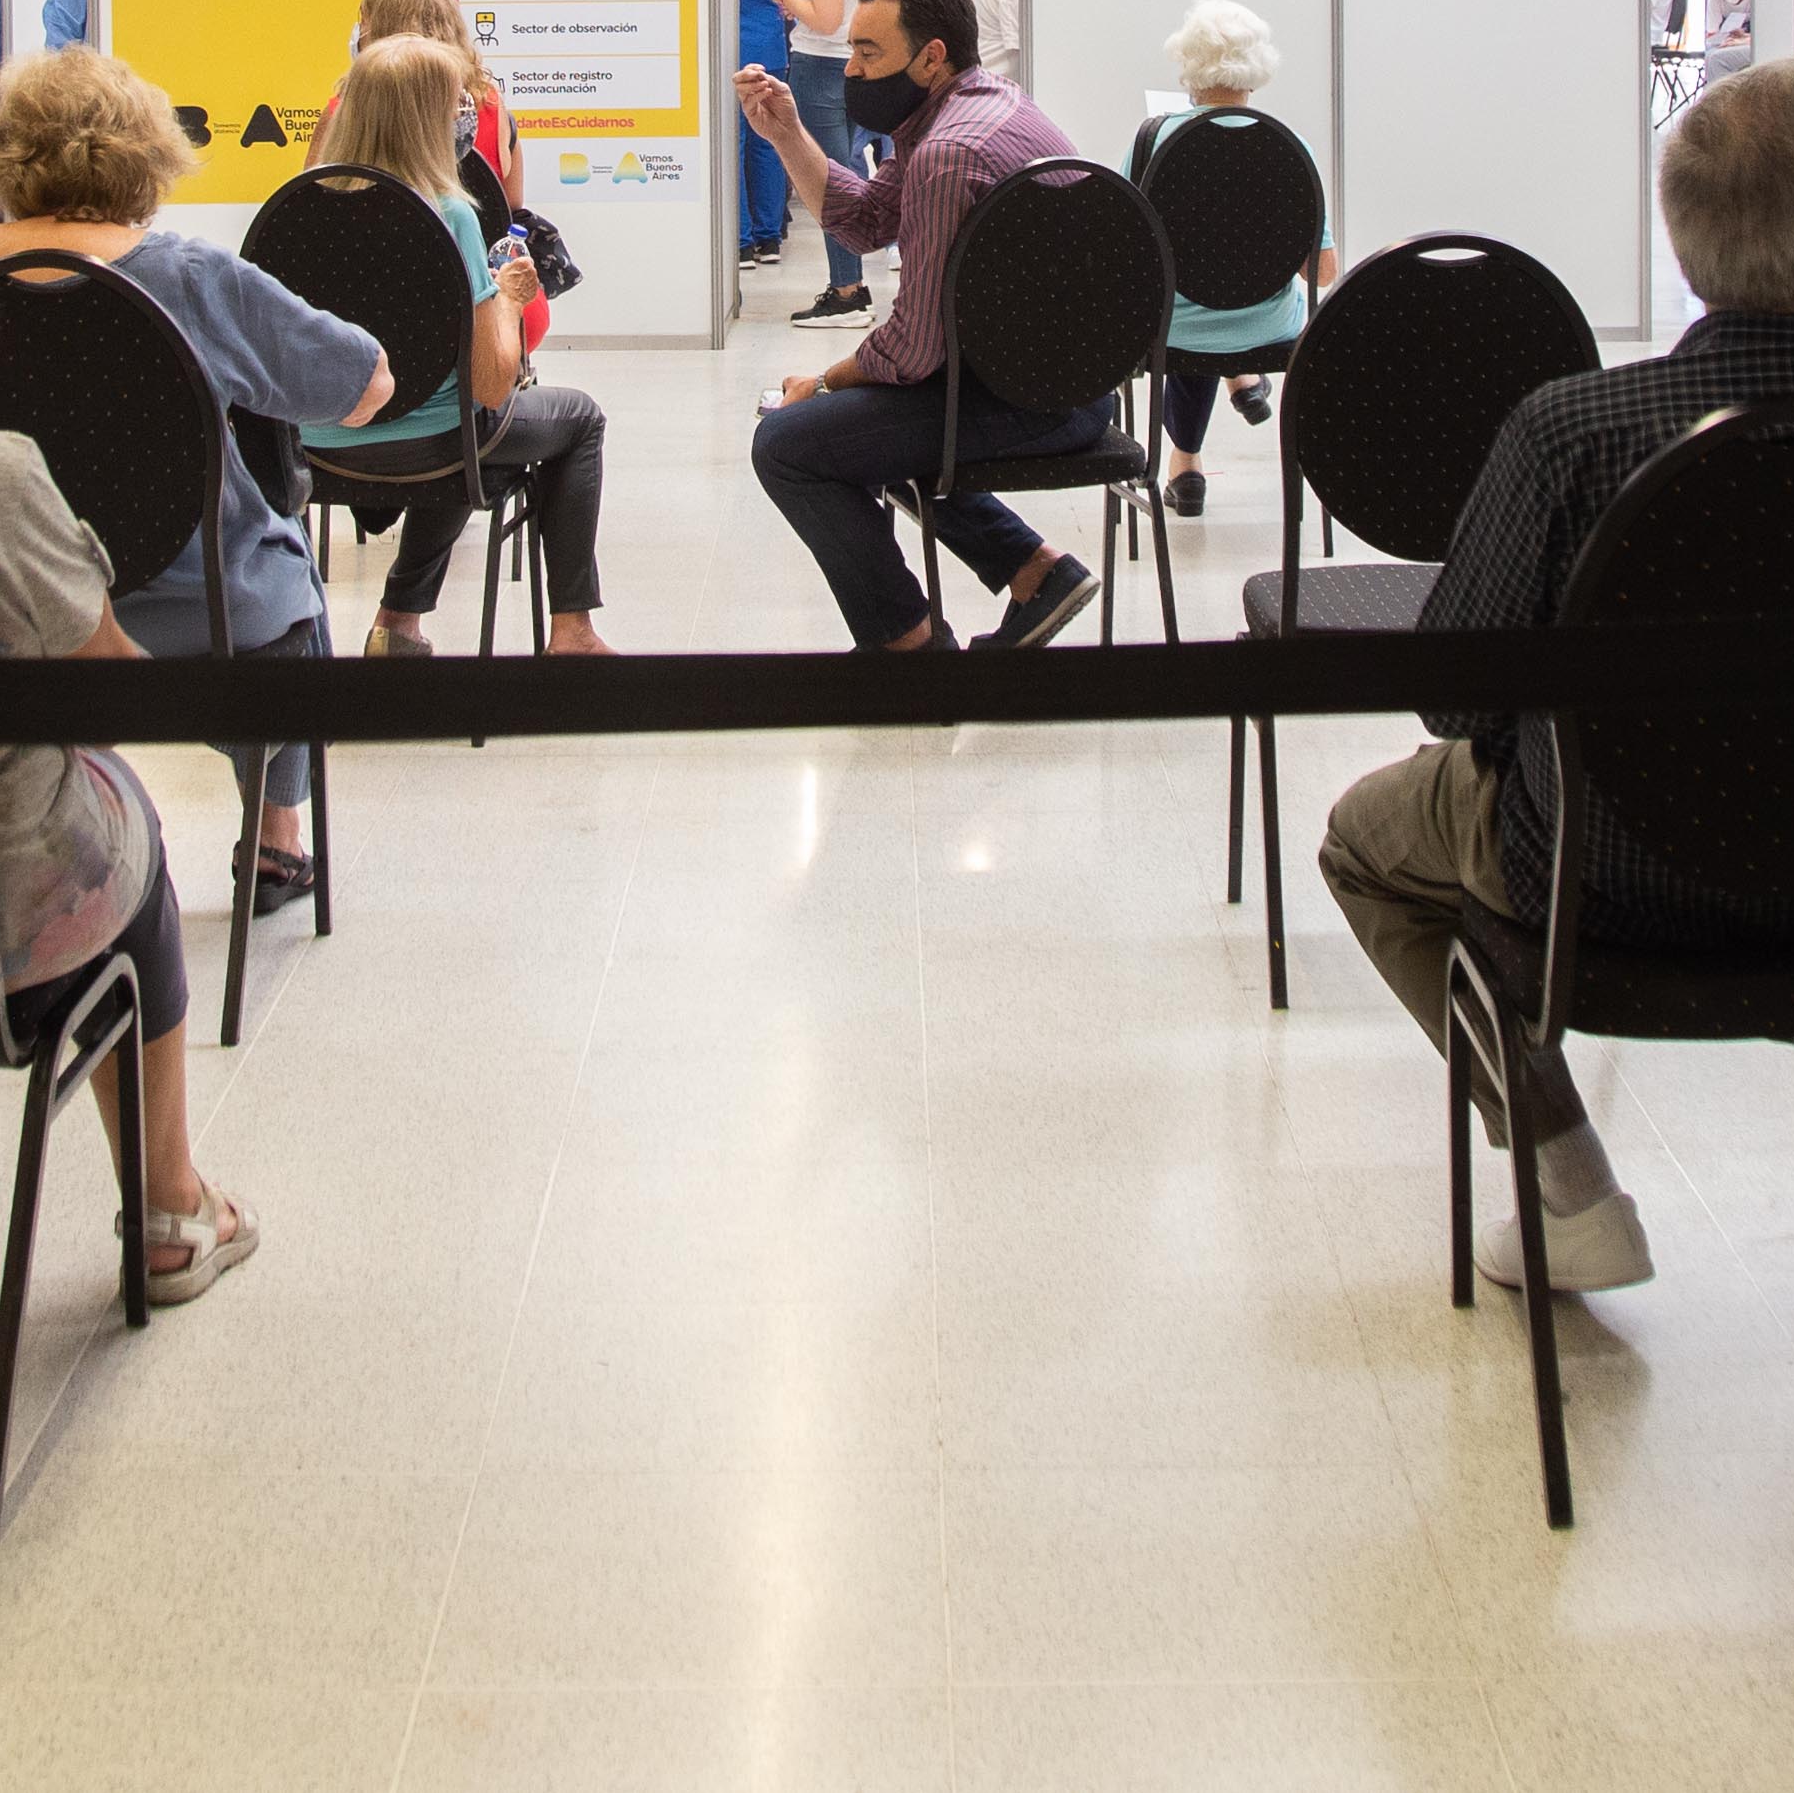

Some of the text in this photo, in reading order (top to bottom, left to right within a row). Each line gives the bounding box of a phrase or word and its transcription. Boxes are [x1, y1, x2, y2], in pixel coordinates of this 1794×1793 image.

[512, 23, 638, 34] Sector de observación
[513, 71, 613, 83] Sector de registro
[513, 84, 597, 96] posvacunación
[276, 107, 322, 119] Vamos
[241, 104, 288, 148] A
[517, 117, 635, 130] darteEsCuidarnos
[294, 132, 313, 143] Air
[639, 154, 674, 164] Vamos
[559, 151, 648, 185] B A
[646, 163, 684, 172] Buenos
[652, 172, 681, 181] Aires
